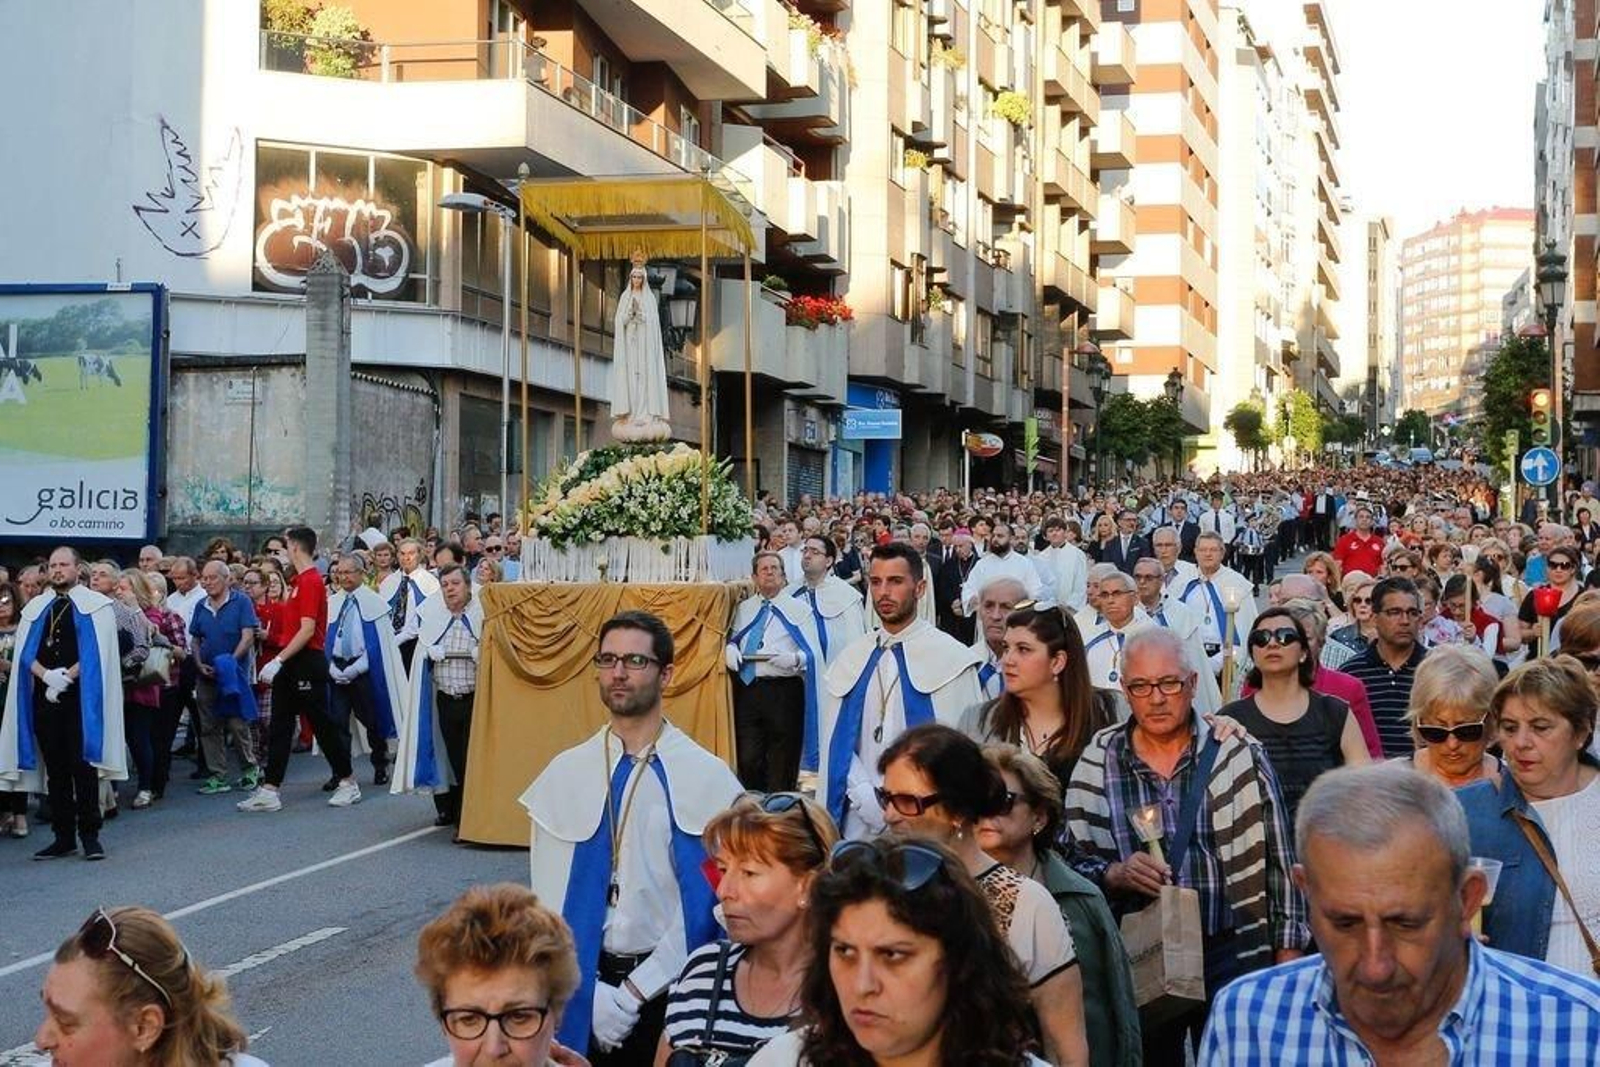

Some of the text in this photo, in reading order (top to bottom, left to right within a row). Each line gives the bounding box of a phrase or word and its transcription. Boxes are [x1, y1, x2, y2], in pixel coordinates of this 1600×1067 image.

[6, 480, 138, 525] galicia
[49, 519, 59, 528] o
[60, 516, 76, 529] bo
